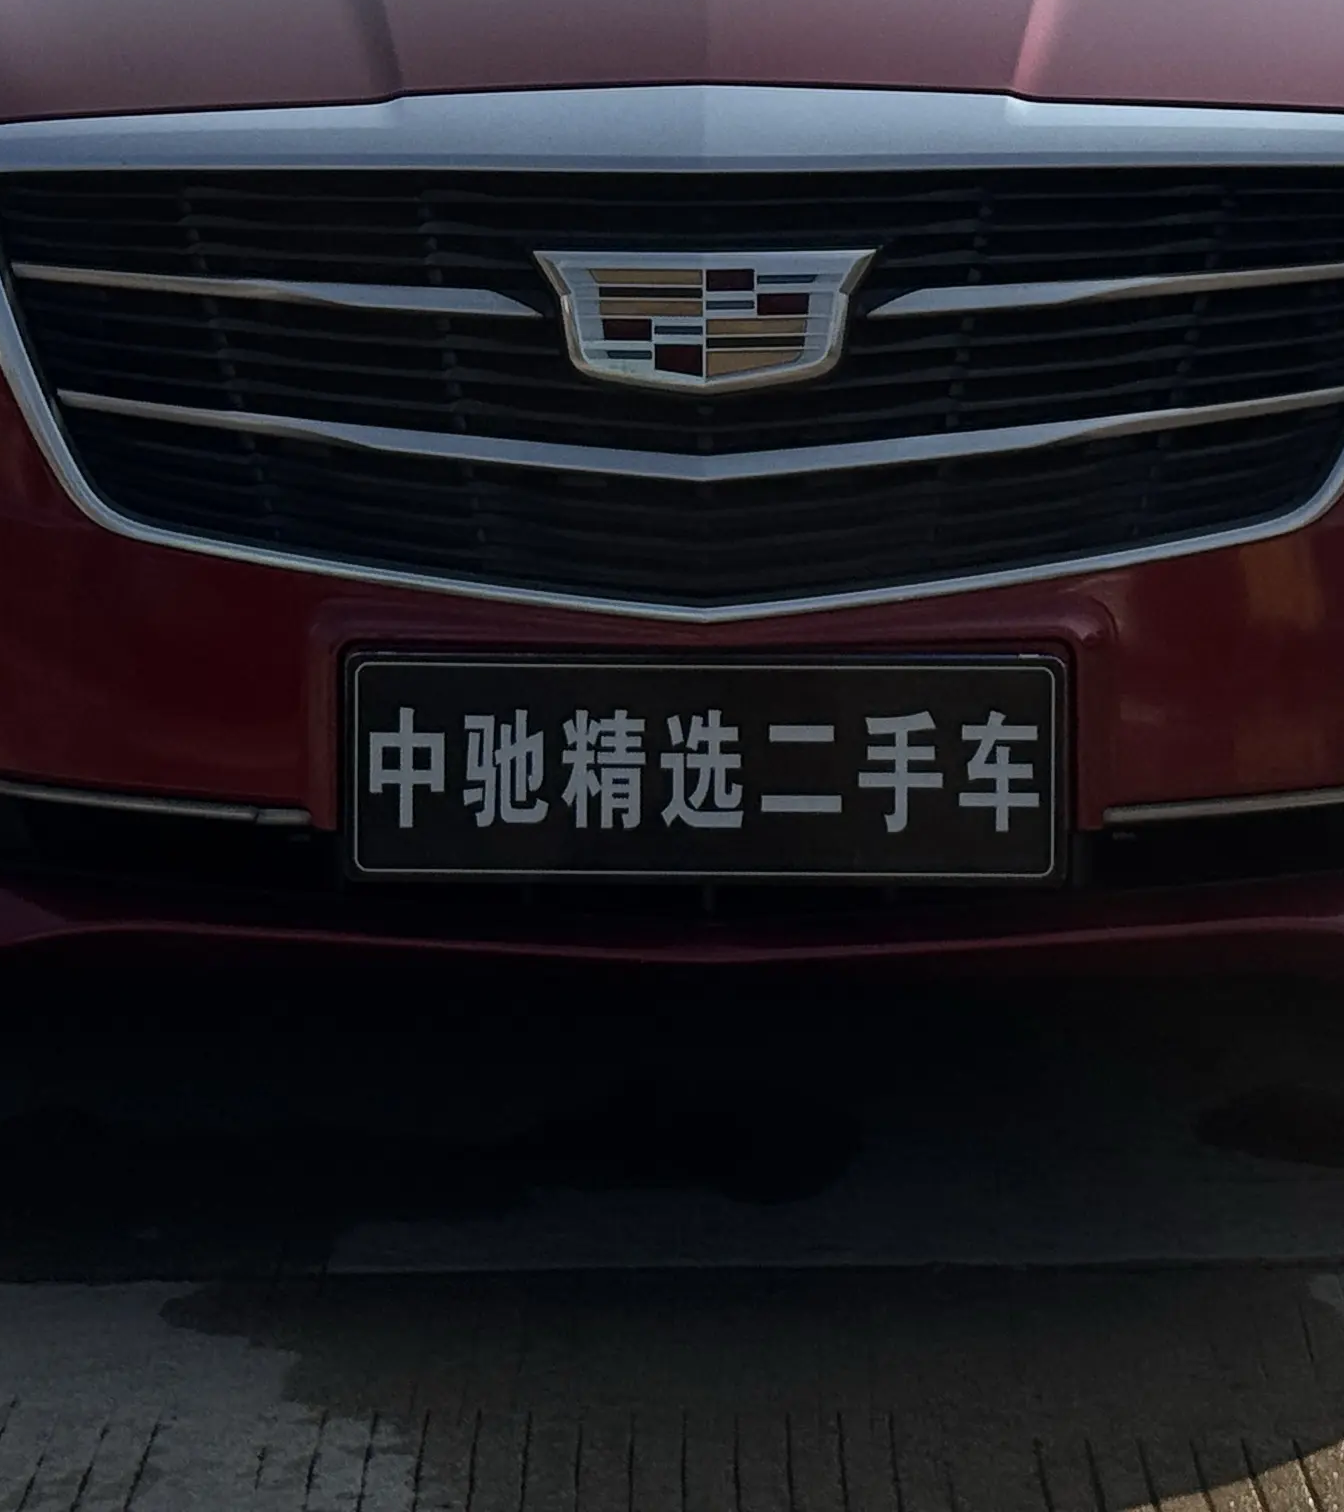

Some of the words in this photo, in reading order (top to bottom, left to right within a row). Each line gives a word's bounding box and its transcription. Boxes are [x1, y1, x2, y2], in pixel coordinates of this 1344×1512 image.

[368, 706, 1040, 832] 中驰精选二手车
